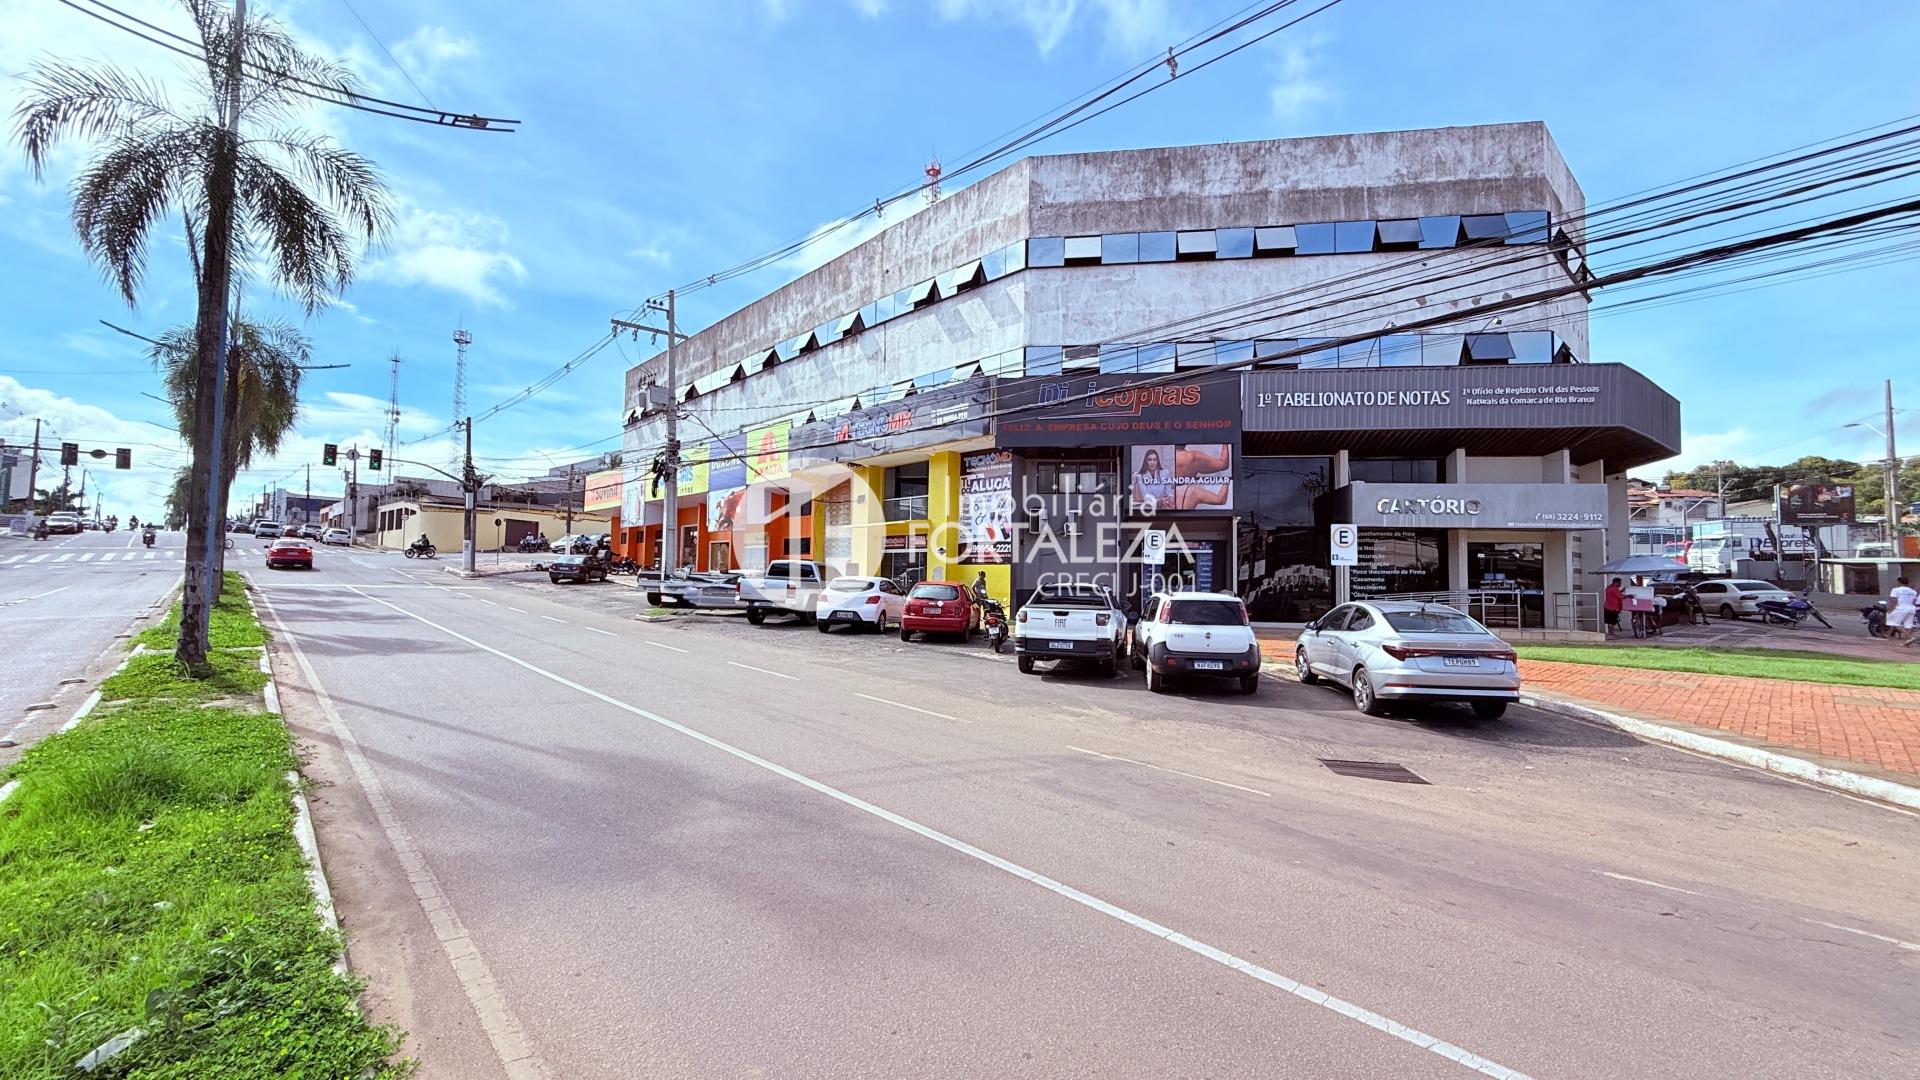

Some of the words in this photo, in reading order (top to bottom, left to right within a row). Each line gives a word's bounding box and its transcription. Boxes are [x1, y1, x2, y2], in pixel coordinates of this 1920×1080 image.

[1495, 387, 1504, 395] de
[1505, 386, 1537, 396] Registro
[1538, 386, 1554, 394] Civil
[1570, 385, 1600, 393] Pessoas
[1274, 391, 1375, 407] TABELIONATO
[1377, 391, 1397, 406] DE
[1399, 390, 1451, 406] NOTAS
[1466, 397, 1498, 405] Naturais
[1499, 397, 1509, 405] da
[1510, 396, 1543, 404] Comarca
[1544, 396, 1554, 404] de
[1555, 396, 1568, 404] Rio
[1569, 395, 1595, 403] Branco
[1047, 423, 1098, 432] EMPRESA
[1101, 422, 1129, 430] CUJO
[1132, 421, 1161, 430] DEUS
[1185, 420, 1233, 429] SENHOR
[1162, 476, 1196, 484] SANDRA
[1197, 476, 1230, 484] AGUIAR
[1376, 495, 1482, 515] CARTÓRIO
[1557, 513, 1603, 521] 3224-9112
[1150, 535, 1159, 547] E
[1339, 530, 1349, 545] E
[1054, 618, 1067, 628] FIAT
